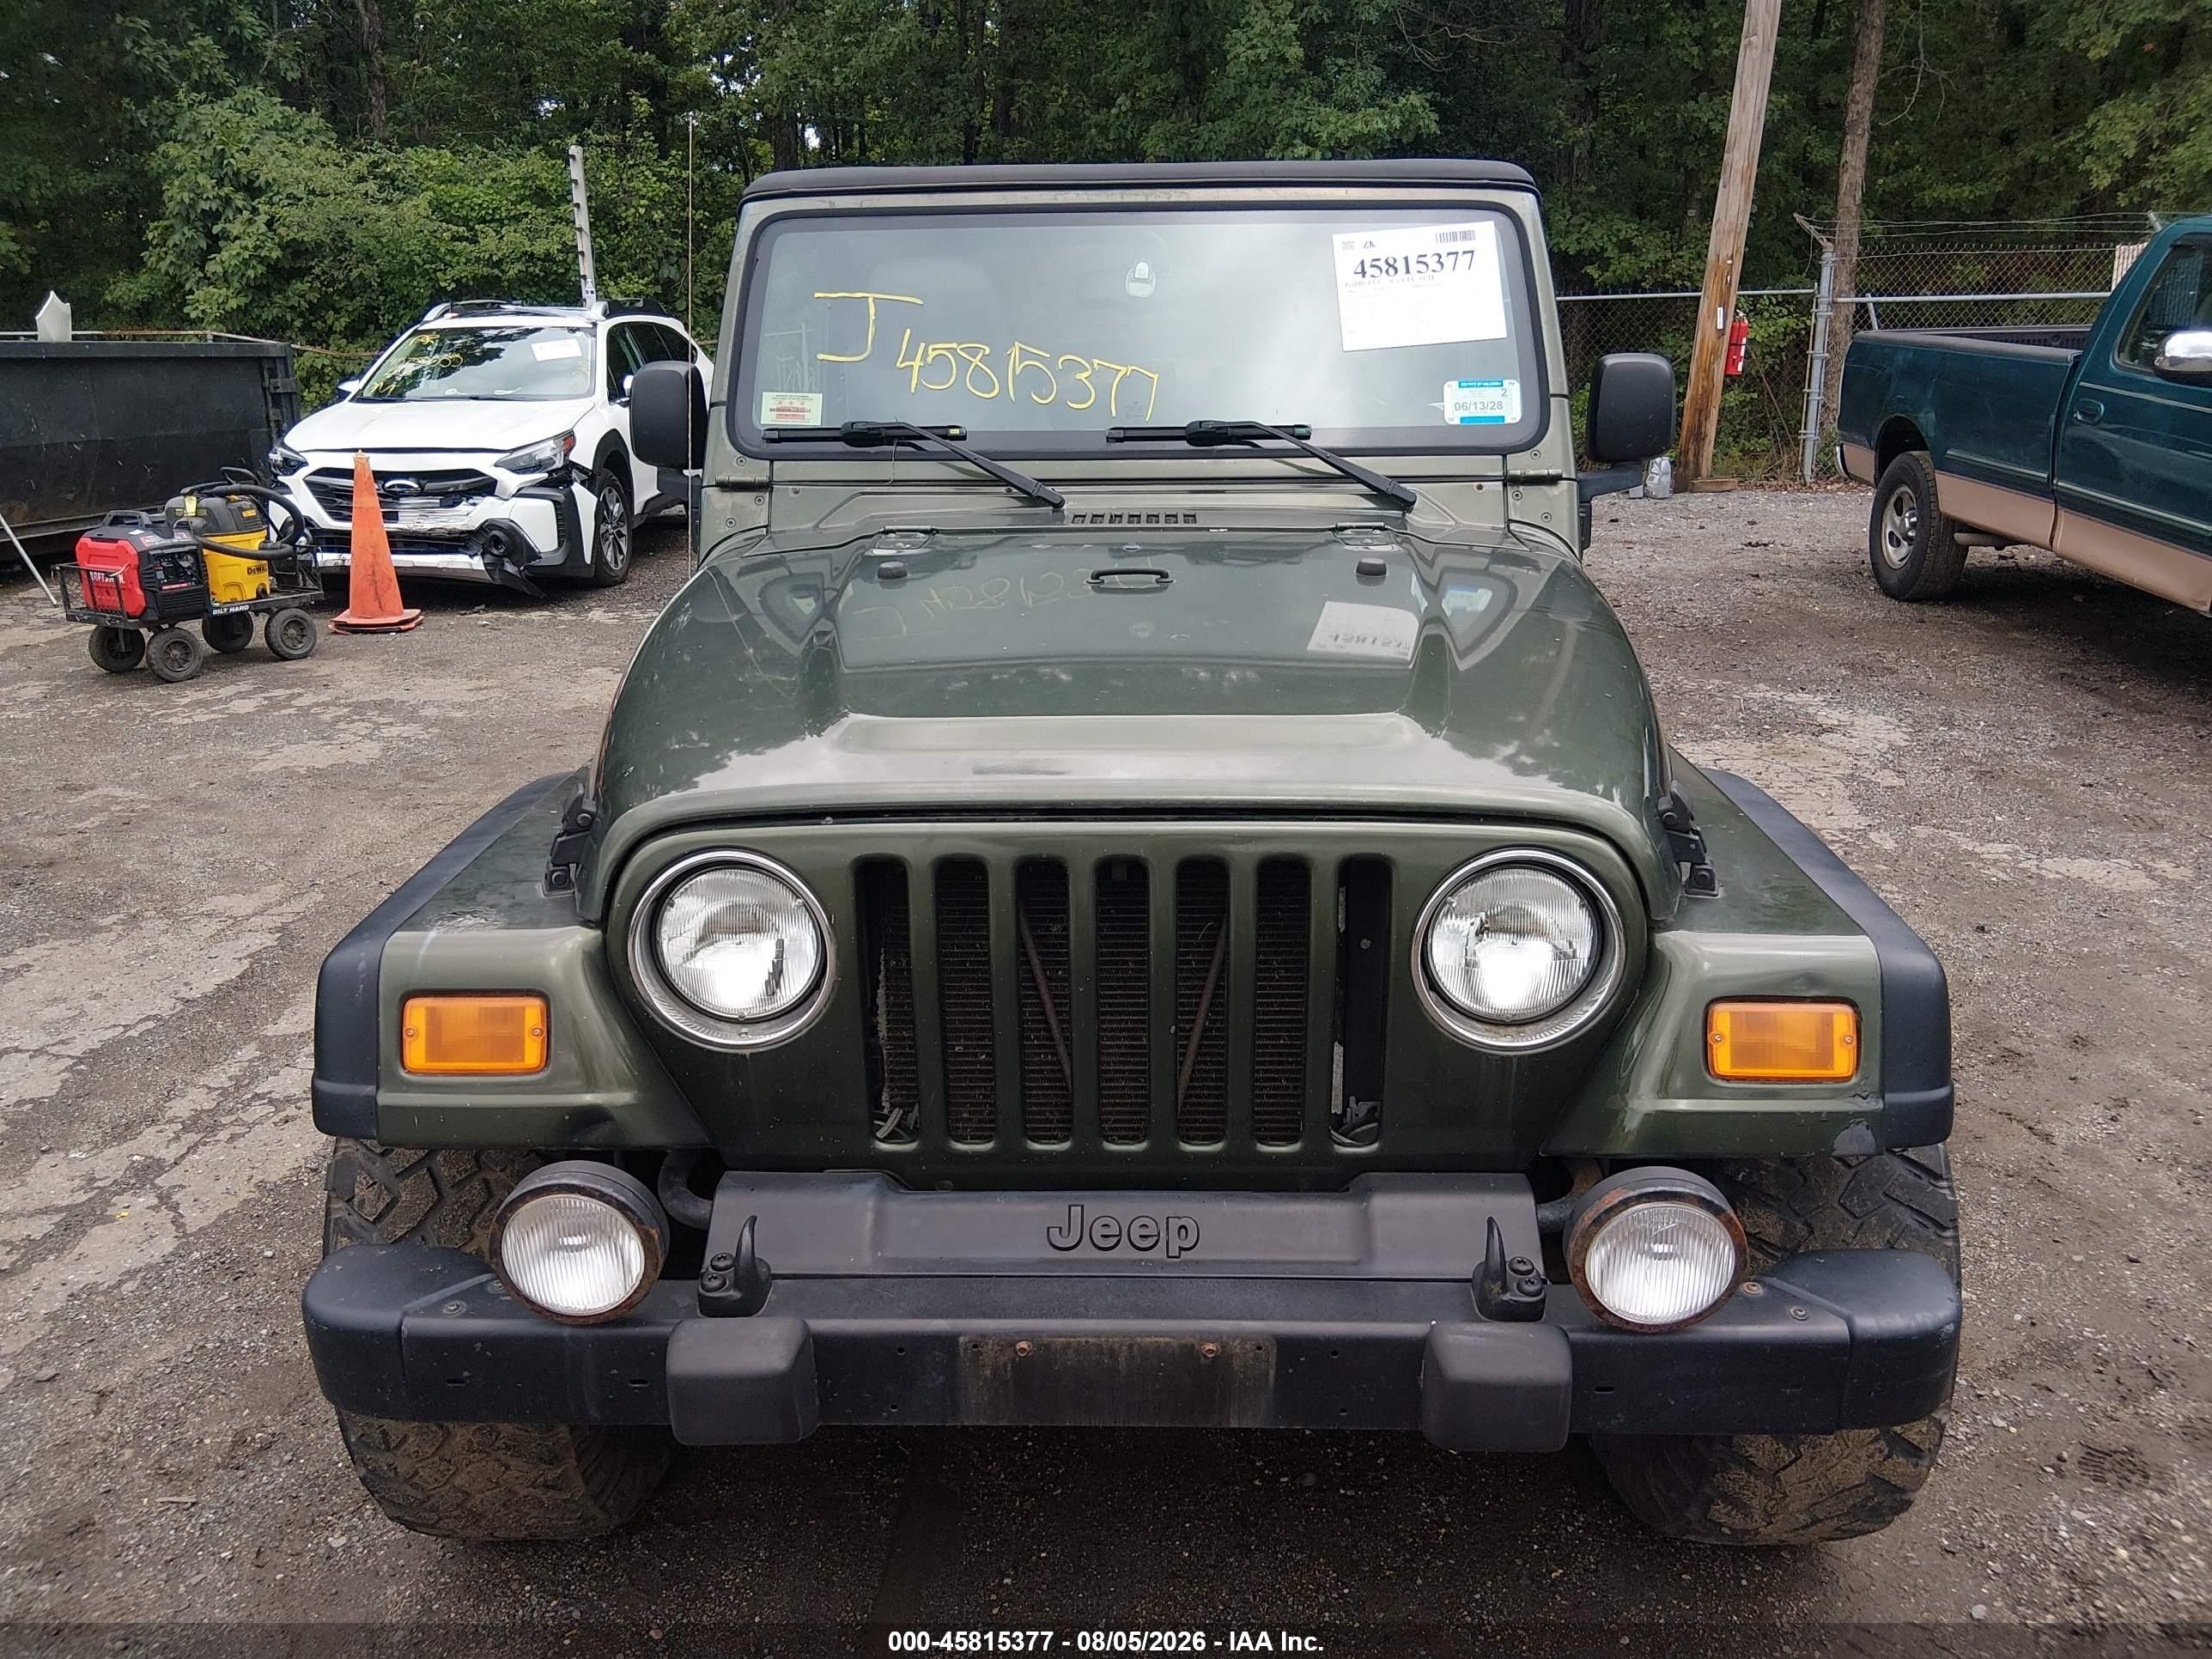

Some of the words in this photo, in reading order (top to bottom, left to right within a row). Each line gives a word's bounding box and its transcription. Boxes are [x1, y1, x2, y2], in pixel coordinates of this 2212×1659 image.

[1353, 249, 1475, 279] 45815377
[813, 290, 925, 362] J
[896, 327, 1160, 423] 45815377
[1500, 387, 1508, 398] 2
[1454, 400, 1504, 411] 06/13/28
[229, 605, 250, 613] HARD
[1046, 1204, 1200, 1259] Jeep
